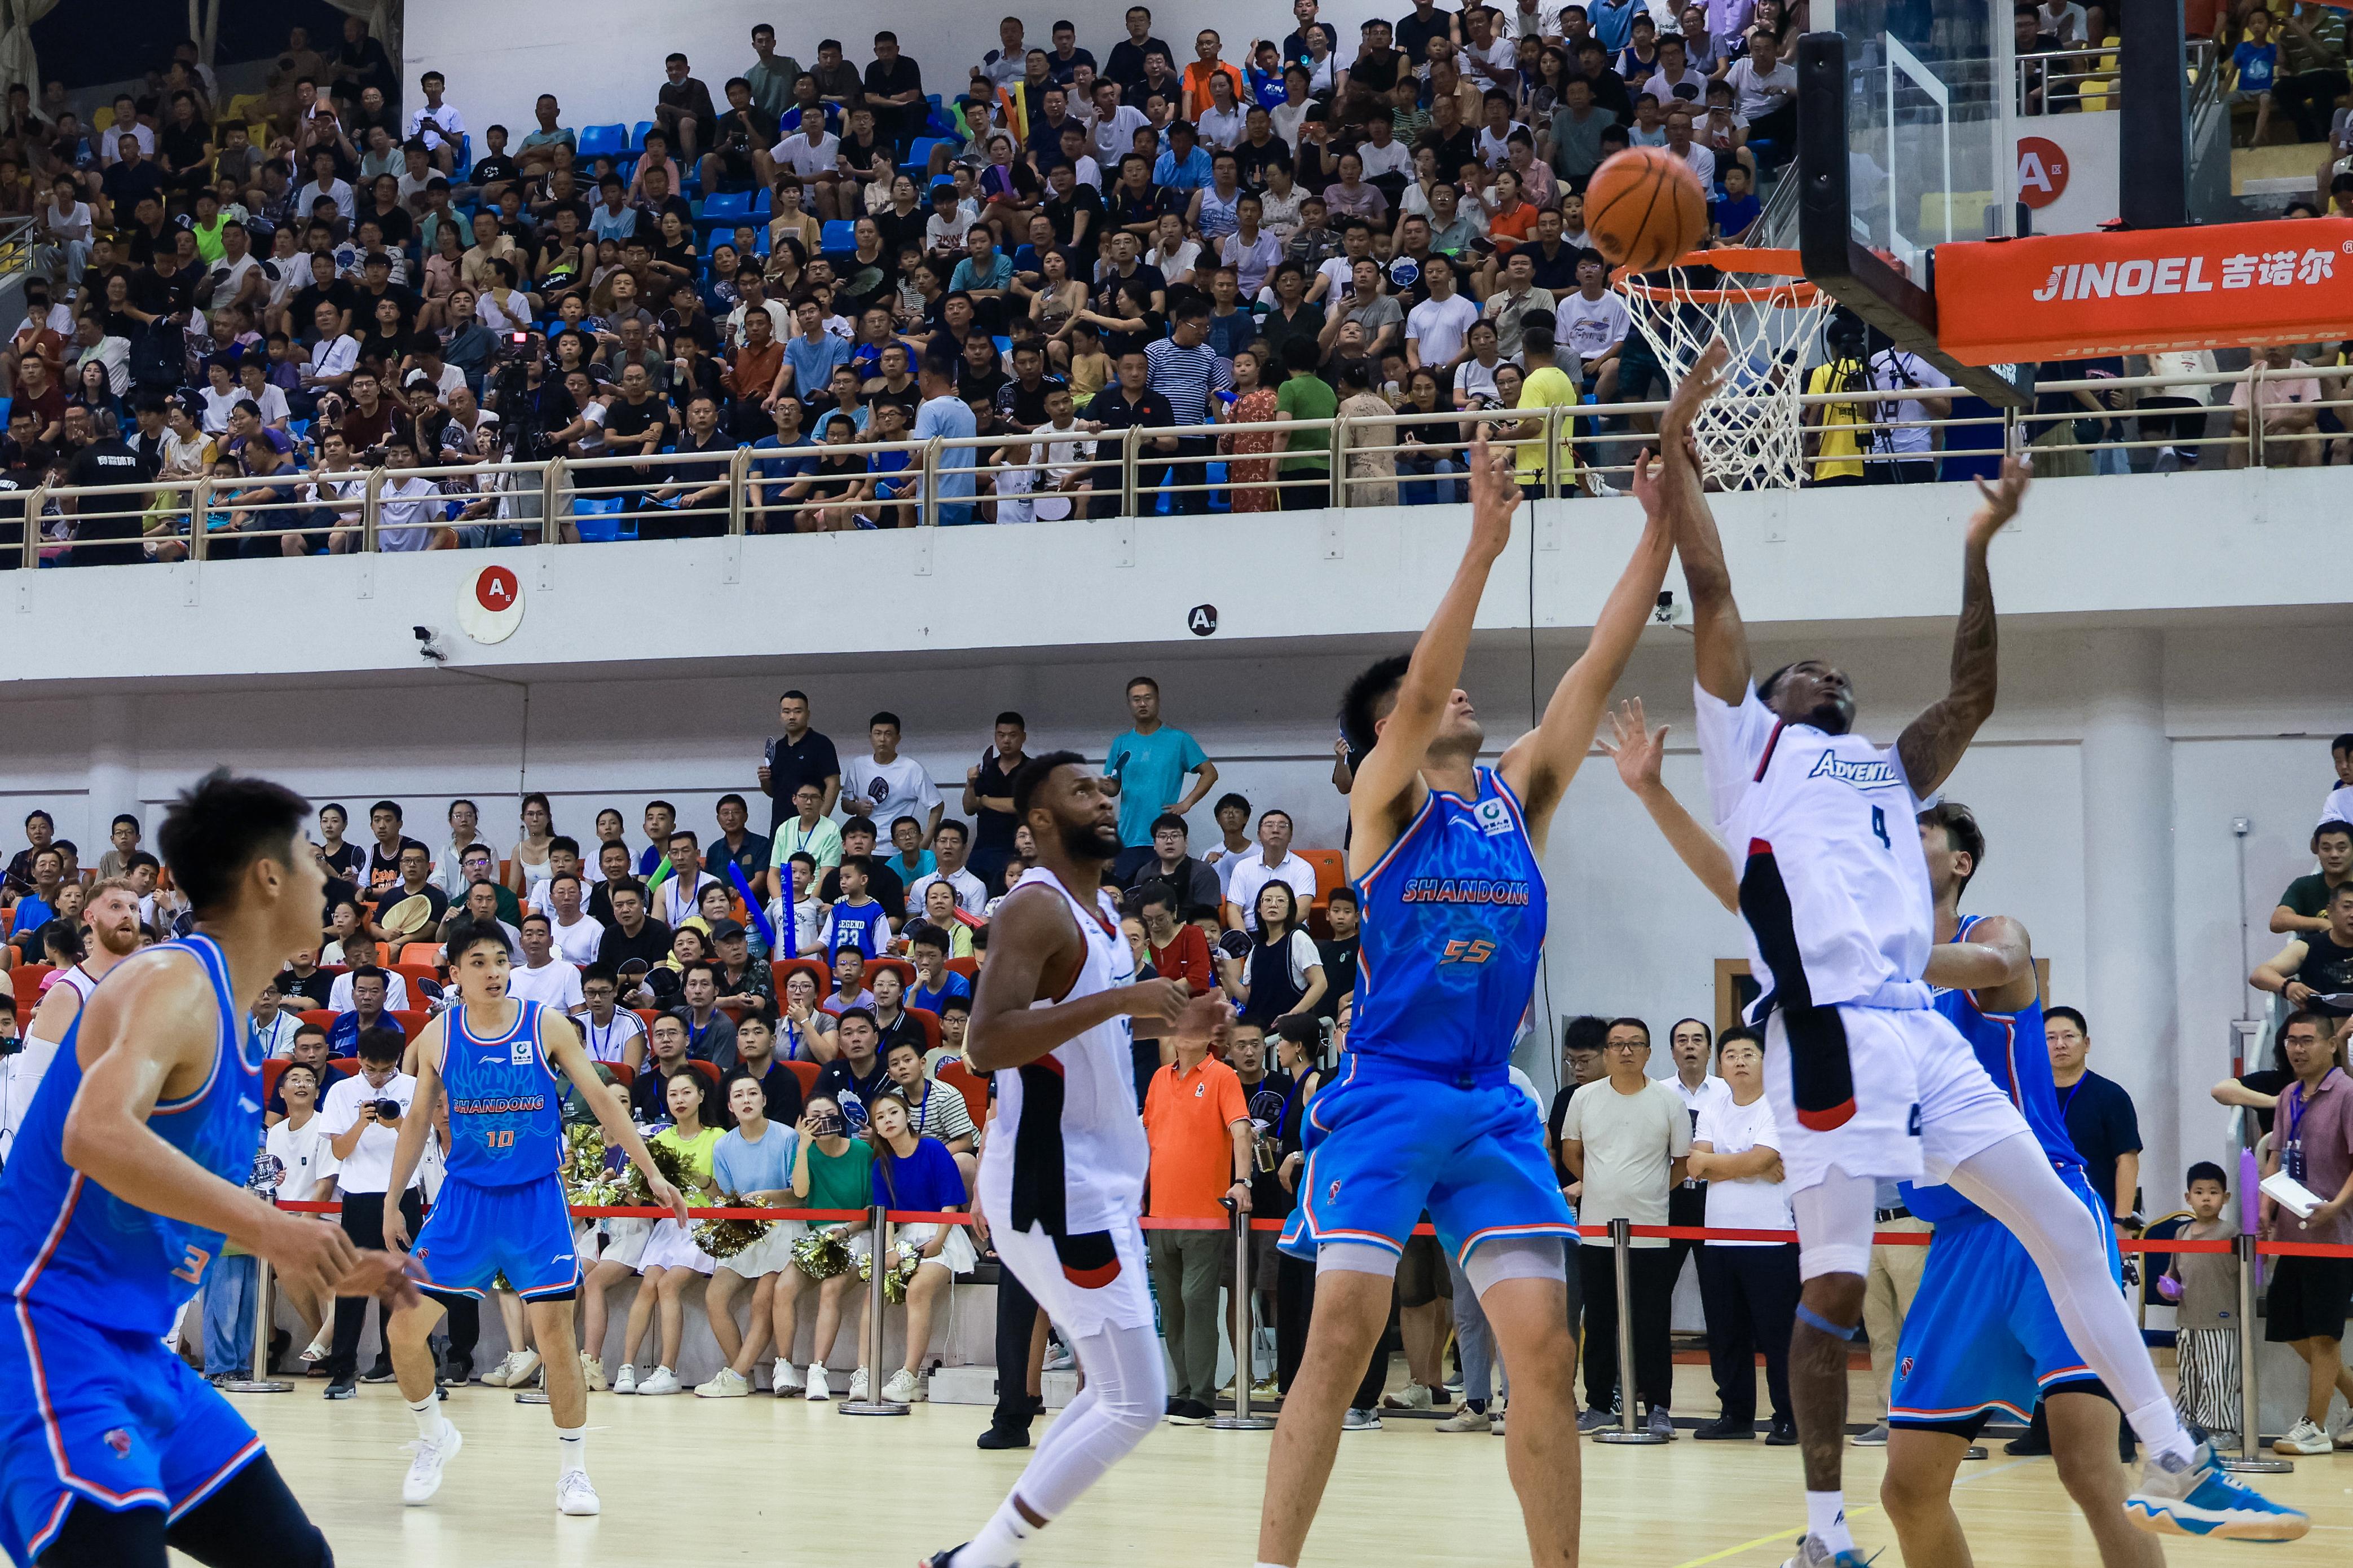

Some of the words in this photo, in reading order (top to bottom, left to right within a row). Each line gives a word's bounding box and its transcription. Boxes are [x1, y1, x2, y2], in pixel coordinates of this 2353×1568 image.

[2018, 152, 2053, 192] A
[2033, 256, 2213, 301] JINOEL
[2222, 248, 2336, 289] 吉诺尔
[488, 578, 505, 596] A
[1191, 609, 1210, 629] A
[1872, 805, 1891, 850] 4
[1402, 878, 1529, 907] SHANDONG
[837, 929, 860, 948] 23
[1440, 939, 1496, 965] 55
[453, 1095, 544, 1114] SHANDONG
[486, 1130, 514, 1147] 10
